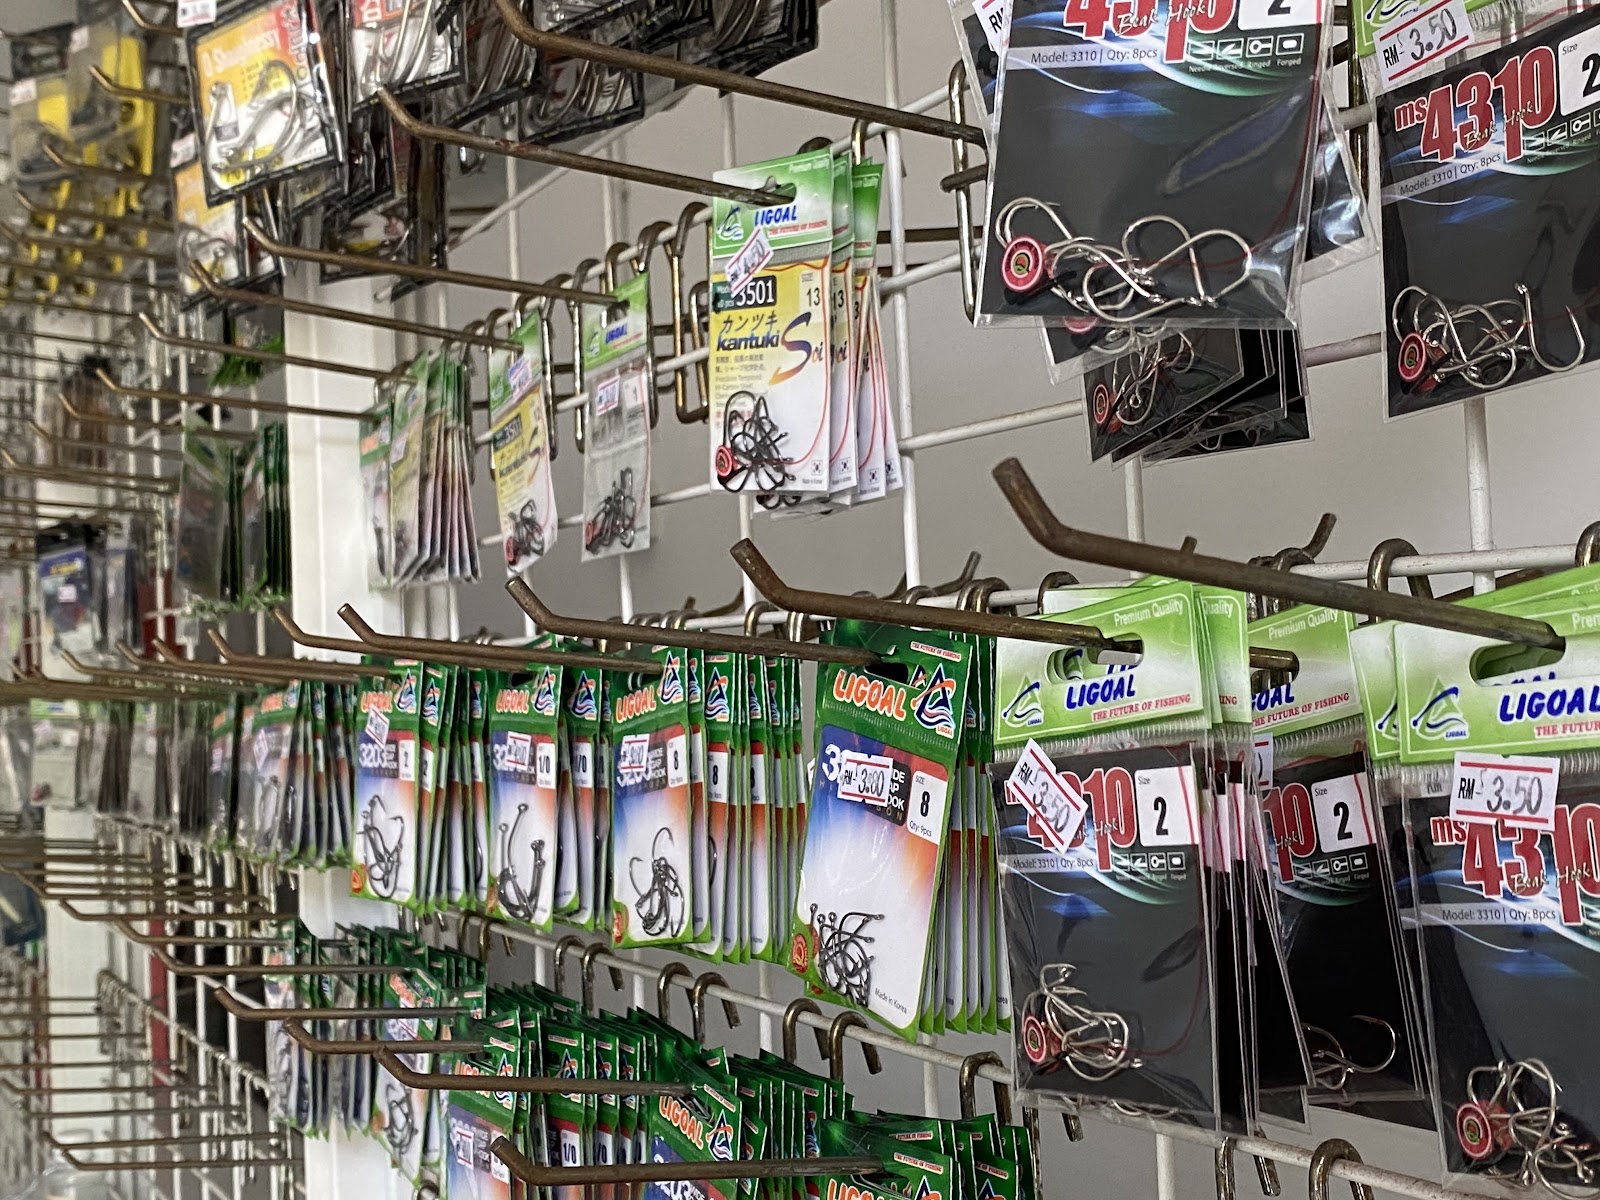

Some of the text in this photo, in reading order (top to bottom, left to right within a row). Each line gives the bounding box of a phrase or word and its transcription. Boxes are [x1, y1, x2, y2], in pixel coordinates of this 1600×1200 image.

[1409, 8, 1457, 60] 3.50
[1031, 52, 1068, 63] Model:
[1071, 50, 1097, 62] 3310
[1107, 50, 1130, 62] Qty:
[1132, 48, 1158, 60] 8pcs
[1561, 43, 1600, 97] Size 2
[1400, 179, 1430, 196] Model:
[1432, 169, 1453, 185] 3310
[1459, 160, 1479, 175] Qty:
[1480, 154, 1500, 168] 8pcs
[754, 204, 798, 226] LIGOAL
[736, 280, 775, 306] 3501
[806, 287, 820, 307] 13
[833, 290, 844, 310] 13
[720, 310, 778, 335] カンツキ
[716, 330, 781, 351] kantuki
[1114, 600, 1184, 626] Premium Quality
[1268, 608, 1338, 640] Premium Quality
[833, 668, 907, 721] LIGOAL
[1064, 673, 1136, 709] LIGOAL
[616, 686, 656, 723] LIGOAL
[1092, 694, 1191, 722] THE FUTURE OF FISHING
[1267, 708, 1300, 723] FUTURE
[1302, 703, 1313, 713] OF
[1315, 692, 1350, 708] FISHING
[1536, 724, 1558, 737] THE
[673, 750, 679, 770] 8
[712, 765, 718, 785] 8
[892, 769, 906, 784] DE
[920, 791, 930, 817] 8
[1032, 782, 1070, 833] 3.50
[1138, 776, 1168, 836] Size 2
[1487, 775, 1543, 815] 3.50
[1314, 787, 1353, 841] Size 2
[1013, 859, 1037, 869] Model:
[1038, 858, 1055, 868] 3310
[1060, 858, 1076, 870] Qty:
[1077, 857, 1094, 868] 8pcs
[1442, 909, 1475, 921] Model:
[1477, 908, 1501, 920] 3310
[1509, 908, 1531, 922] Qty:
[1532, 908, 1556, 922] 8pcs
[659, 1095, 703, 1150] LIGOAL
